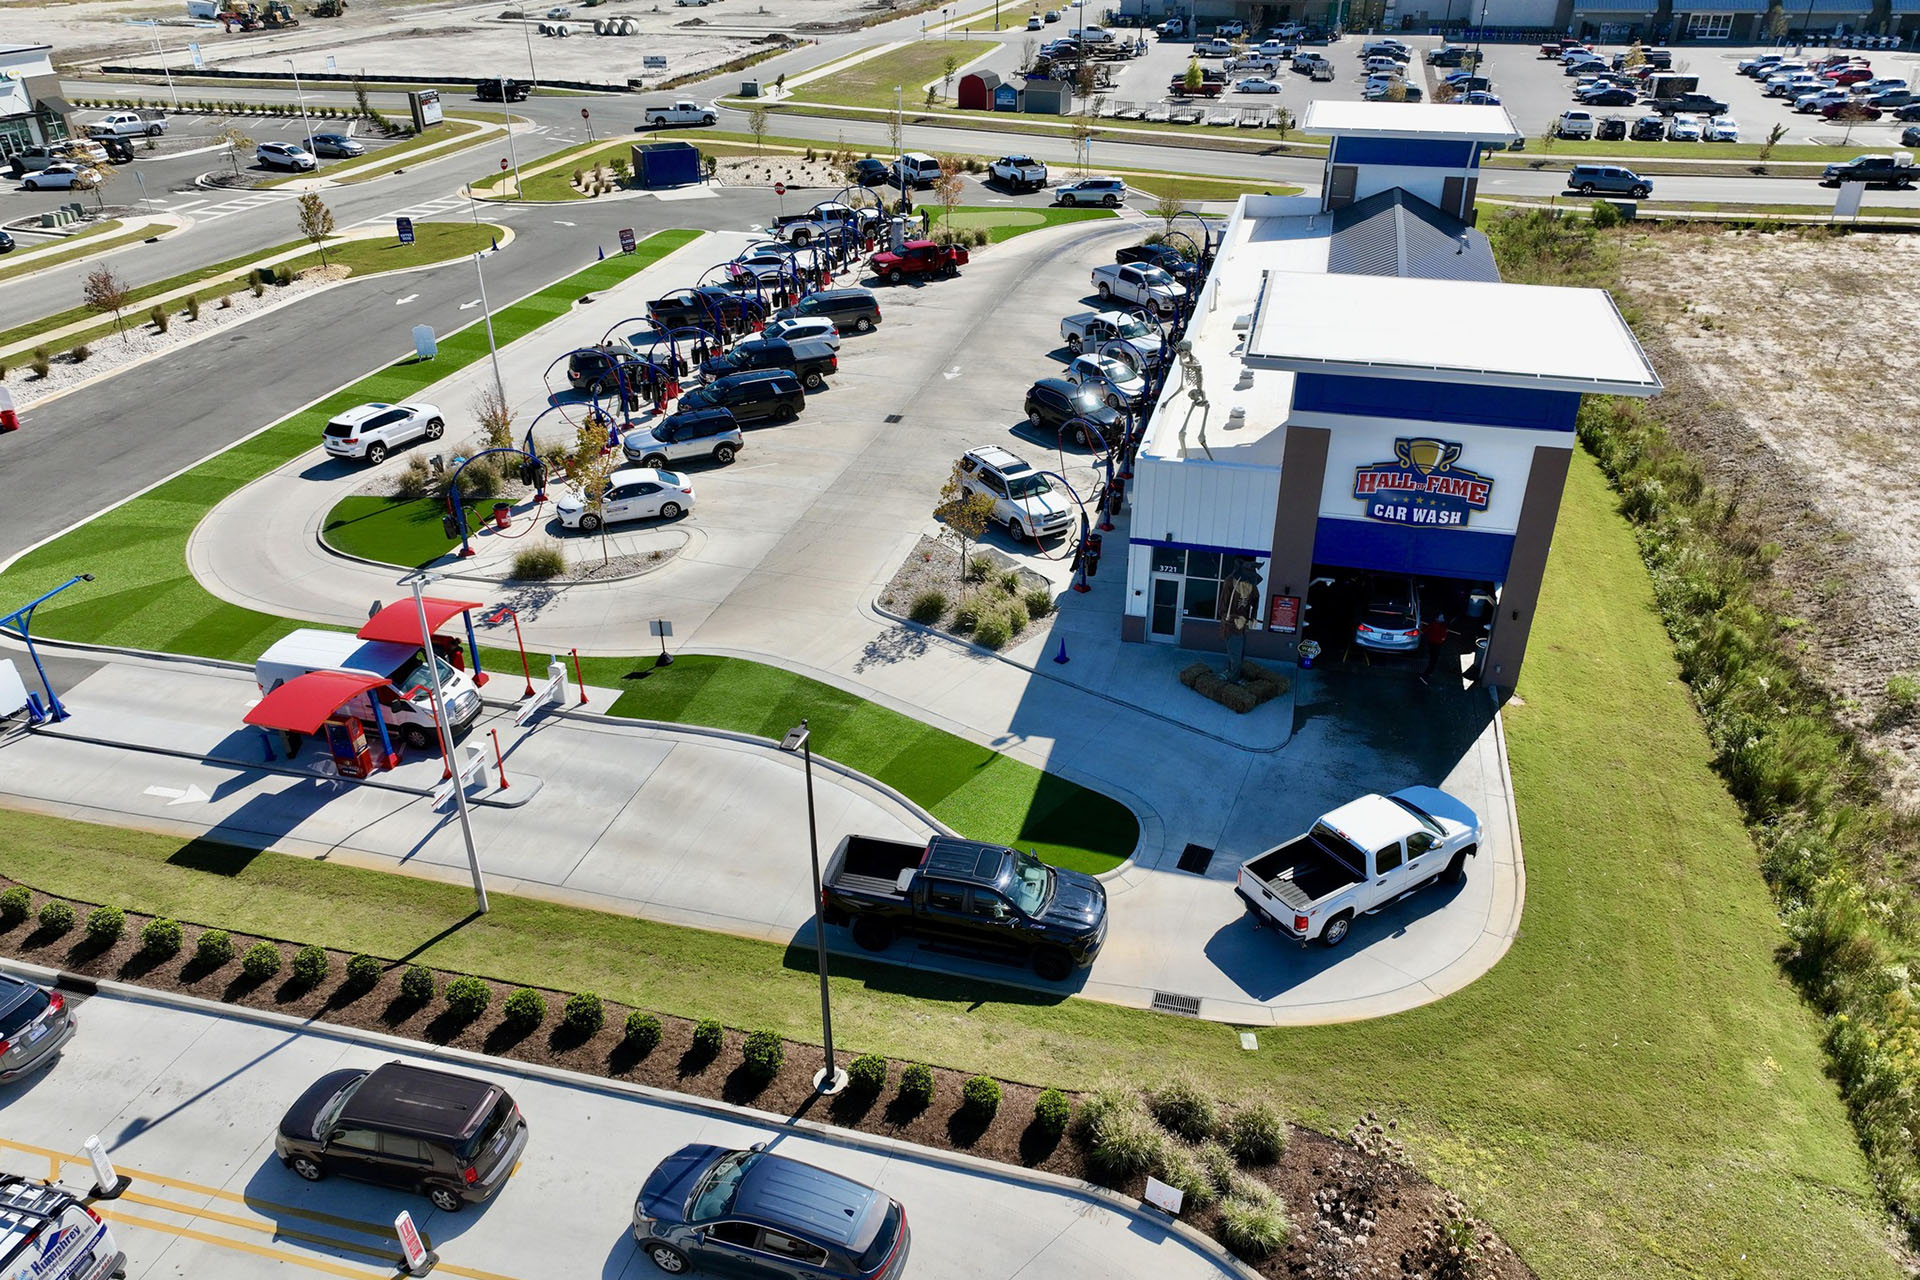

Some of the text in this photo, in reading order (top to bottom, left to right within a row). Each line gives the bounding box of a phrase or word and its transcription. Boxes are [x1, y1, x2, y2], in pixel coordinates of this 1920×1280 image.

[1356, 472, 1416, 494] HALL
[1425, 475, 1489, 506] FAME
[1373, 504, 1462, 524] CAR WASH
[1160, 565, 1177, 573] 3721
[30, 1225, 80, 1276] Humphrey
